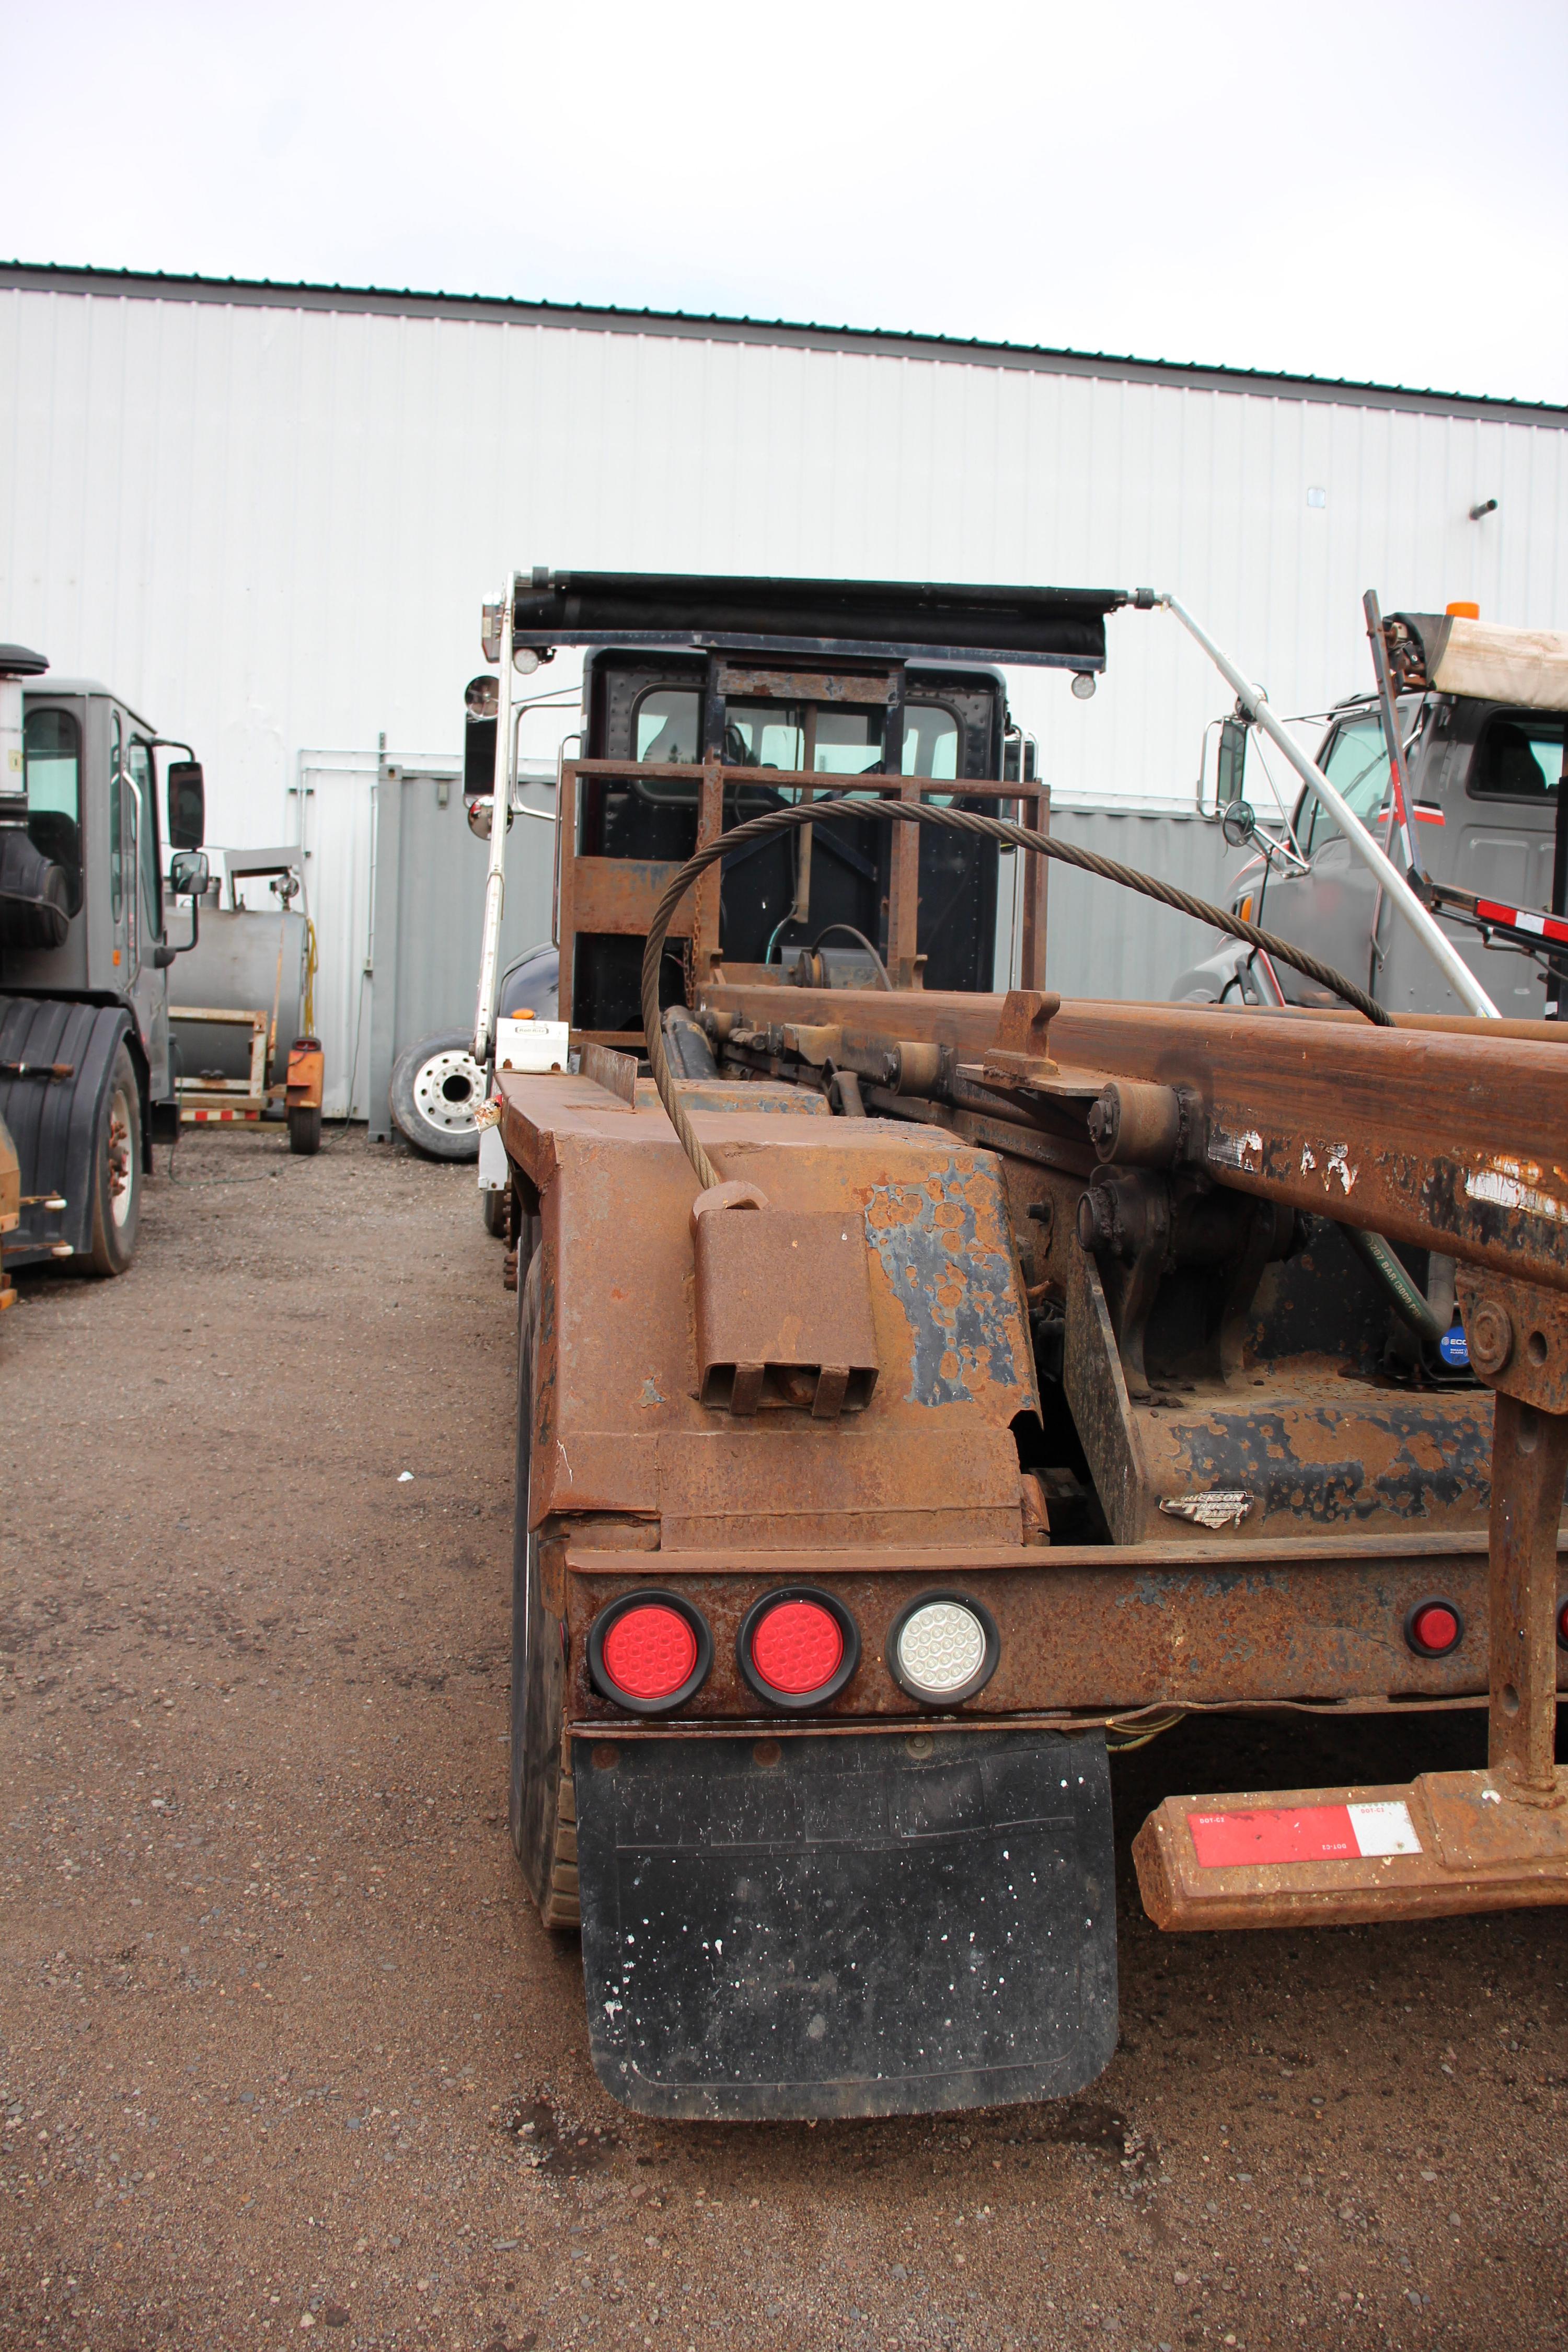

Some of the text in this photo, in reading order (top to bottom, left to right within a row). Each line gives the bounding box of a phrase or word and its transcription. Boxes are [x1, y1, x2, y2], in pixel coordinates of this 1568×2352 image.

[1370, 1244, 1385, 1260] 207
[1381, 1261, 1397, 1281] BAR
[1393, 1281, 1412, 1304] (3000
